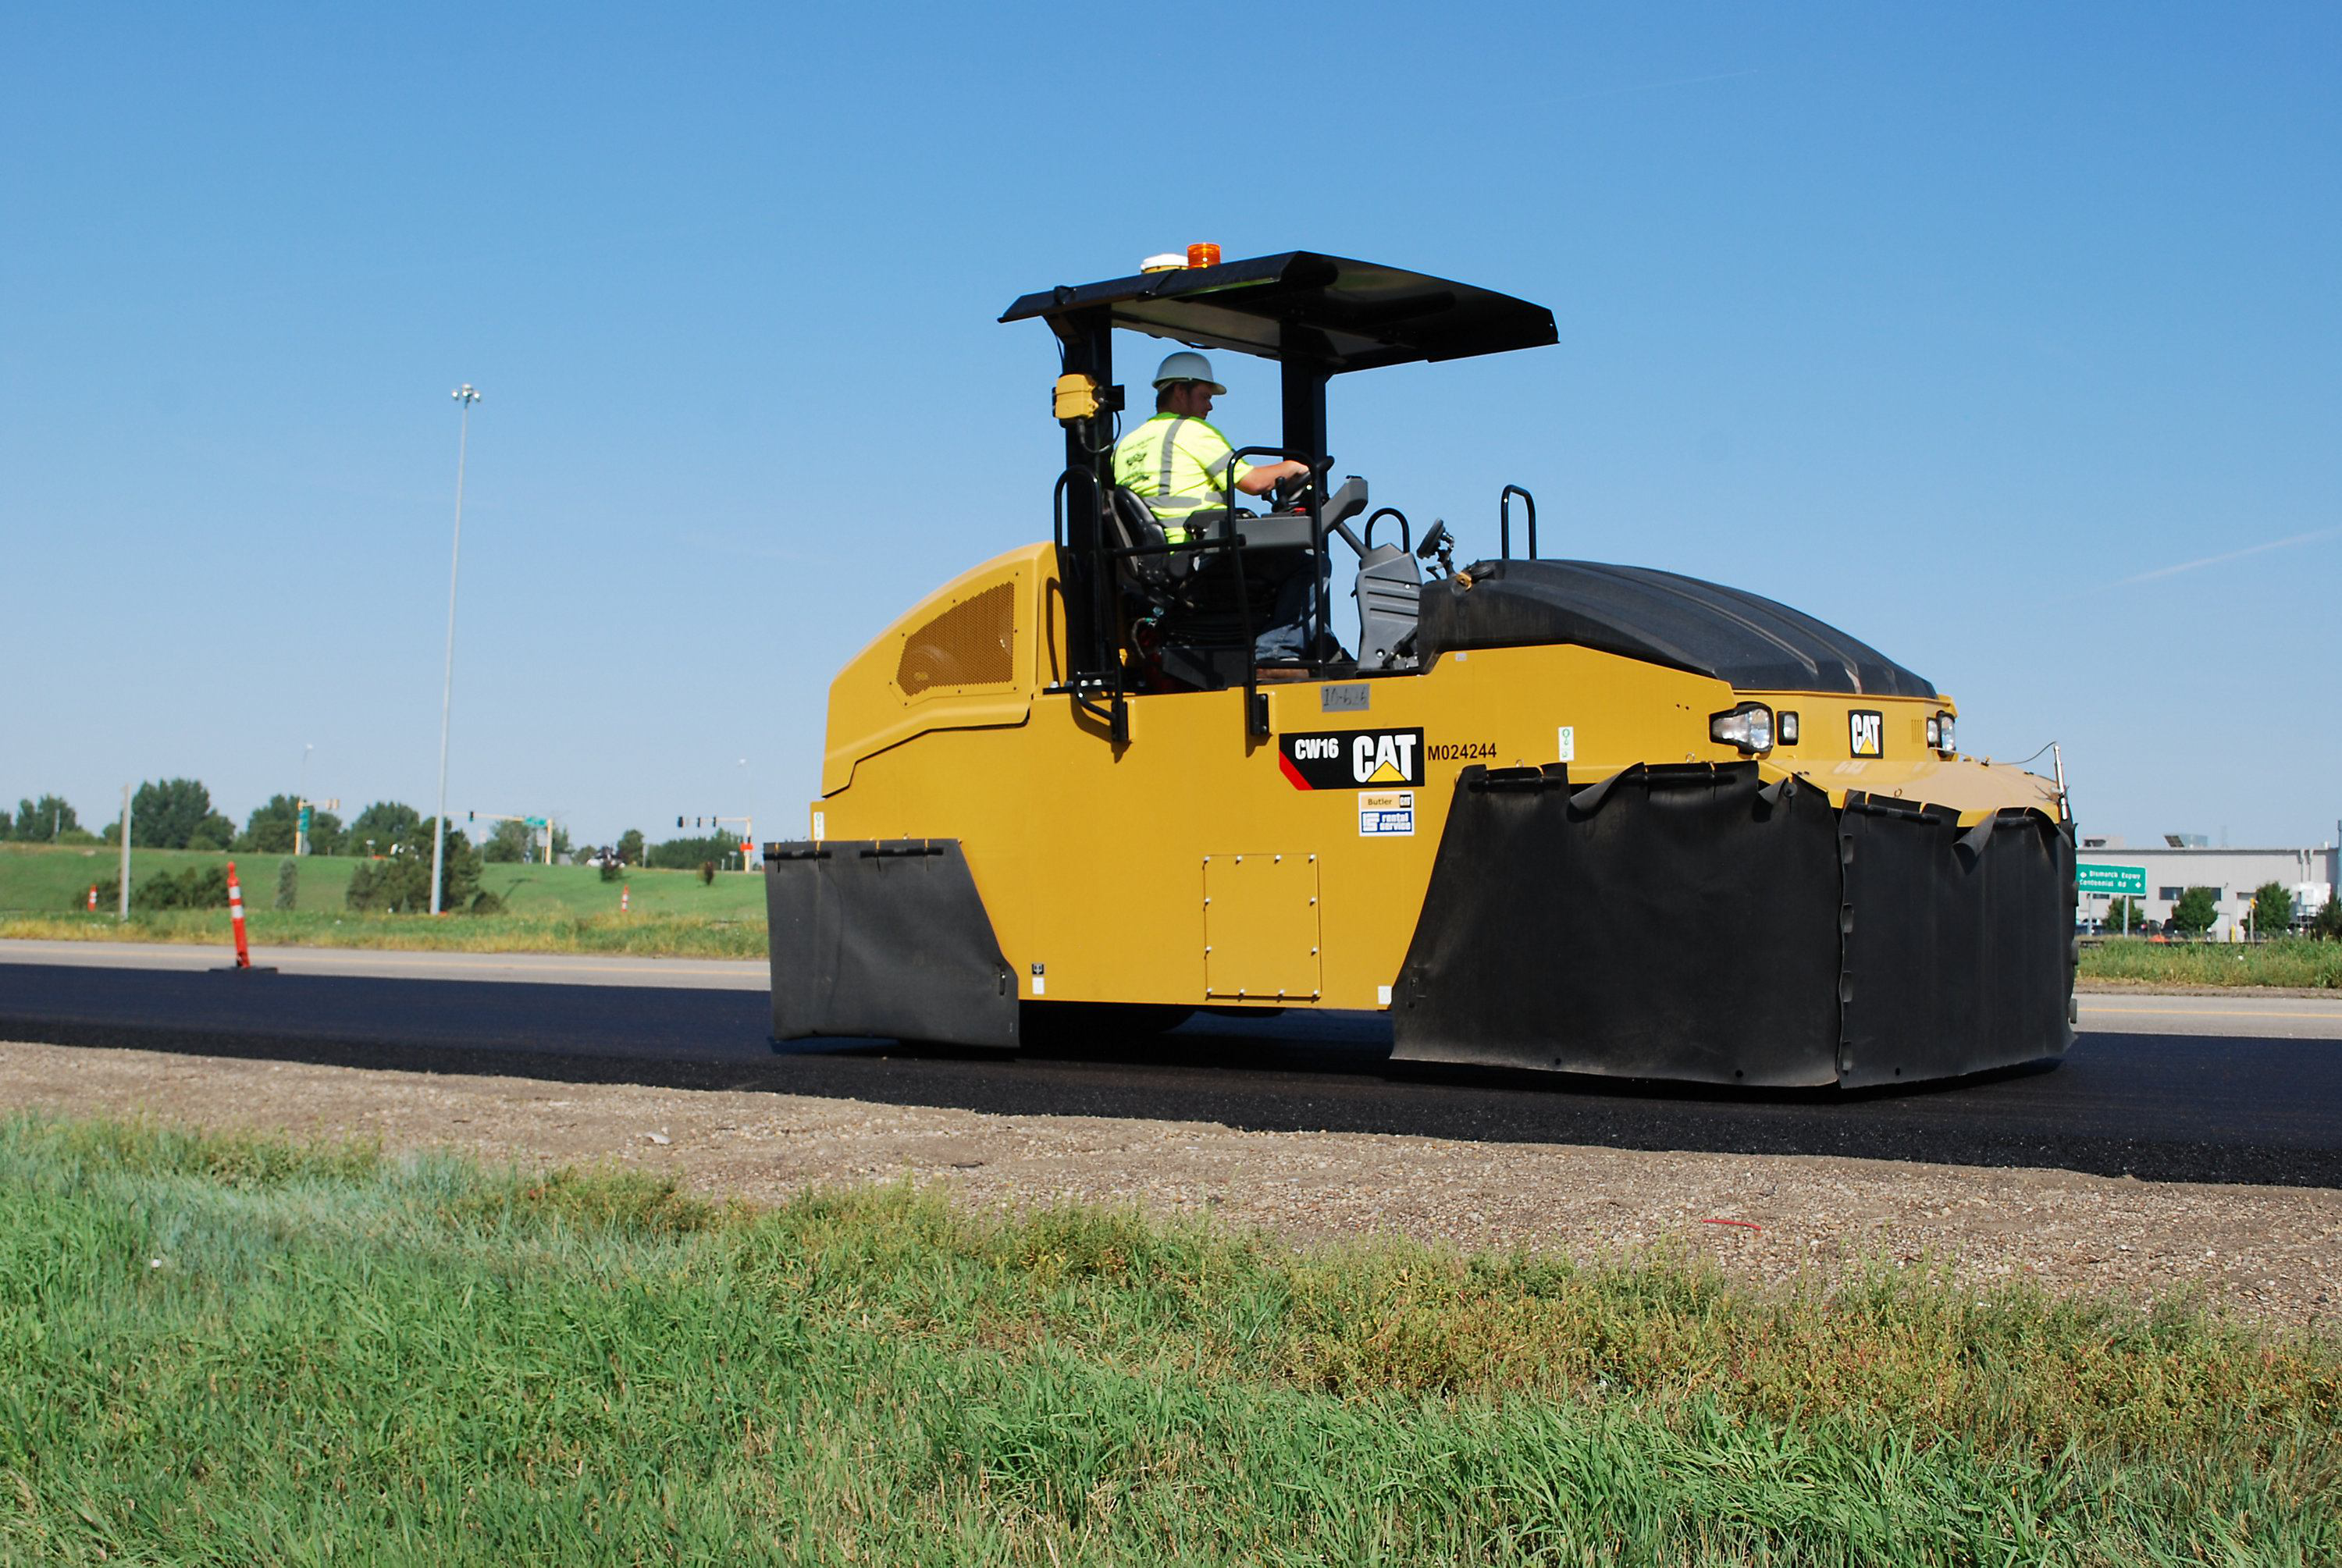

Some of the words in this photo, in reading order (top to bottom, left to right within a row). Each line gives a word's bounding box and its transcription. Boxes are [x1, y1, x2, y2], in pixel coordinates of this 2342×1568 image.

[1427, 743, 1497, 761] M024244
[1851, 713, 1881, 755] CAT
[1294, 738, 1340, 760] CW16
[1352, 734, 1417, 783] CAT
